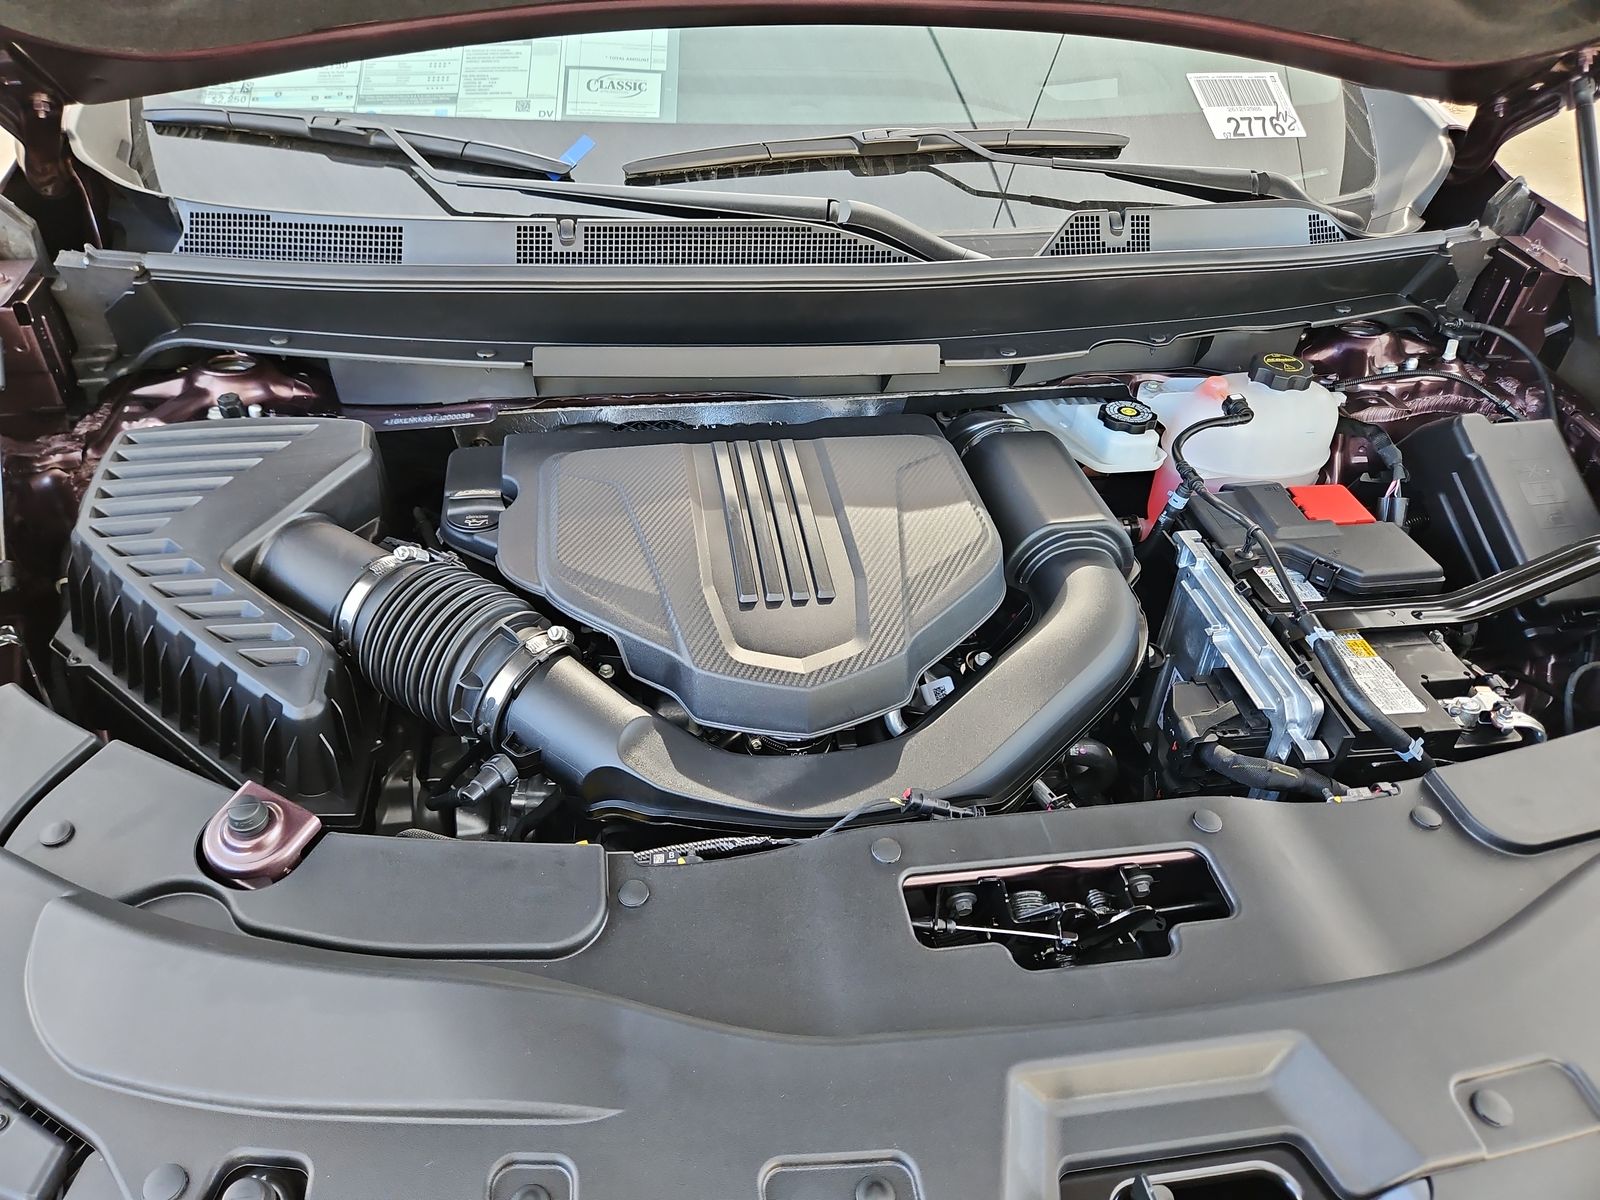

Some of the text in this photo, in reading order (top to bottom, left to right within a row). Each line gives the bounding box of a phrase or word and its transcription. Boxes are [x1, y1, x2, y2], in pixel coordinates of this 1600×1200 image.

[586, 78, 648, 92] CLASSIC
[538, 110, 554, 118] DV
[1226, 116, 1286, 137] 2776
